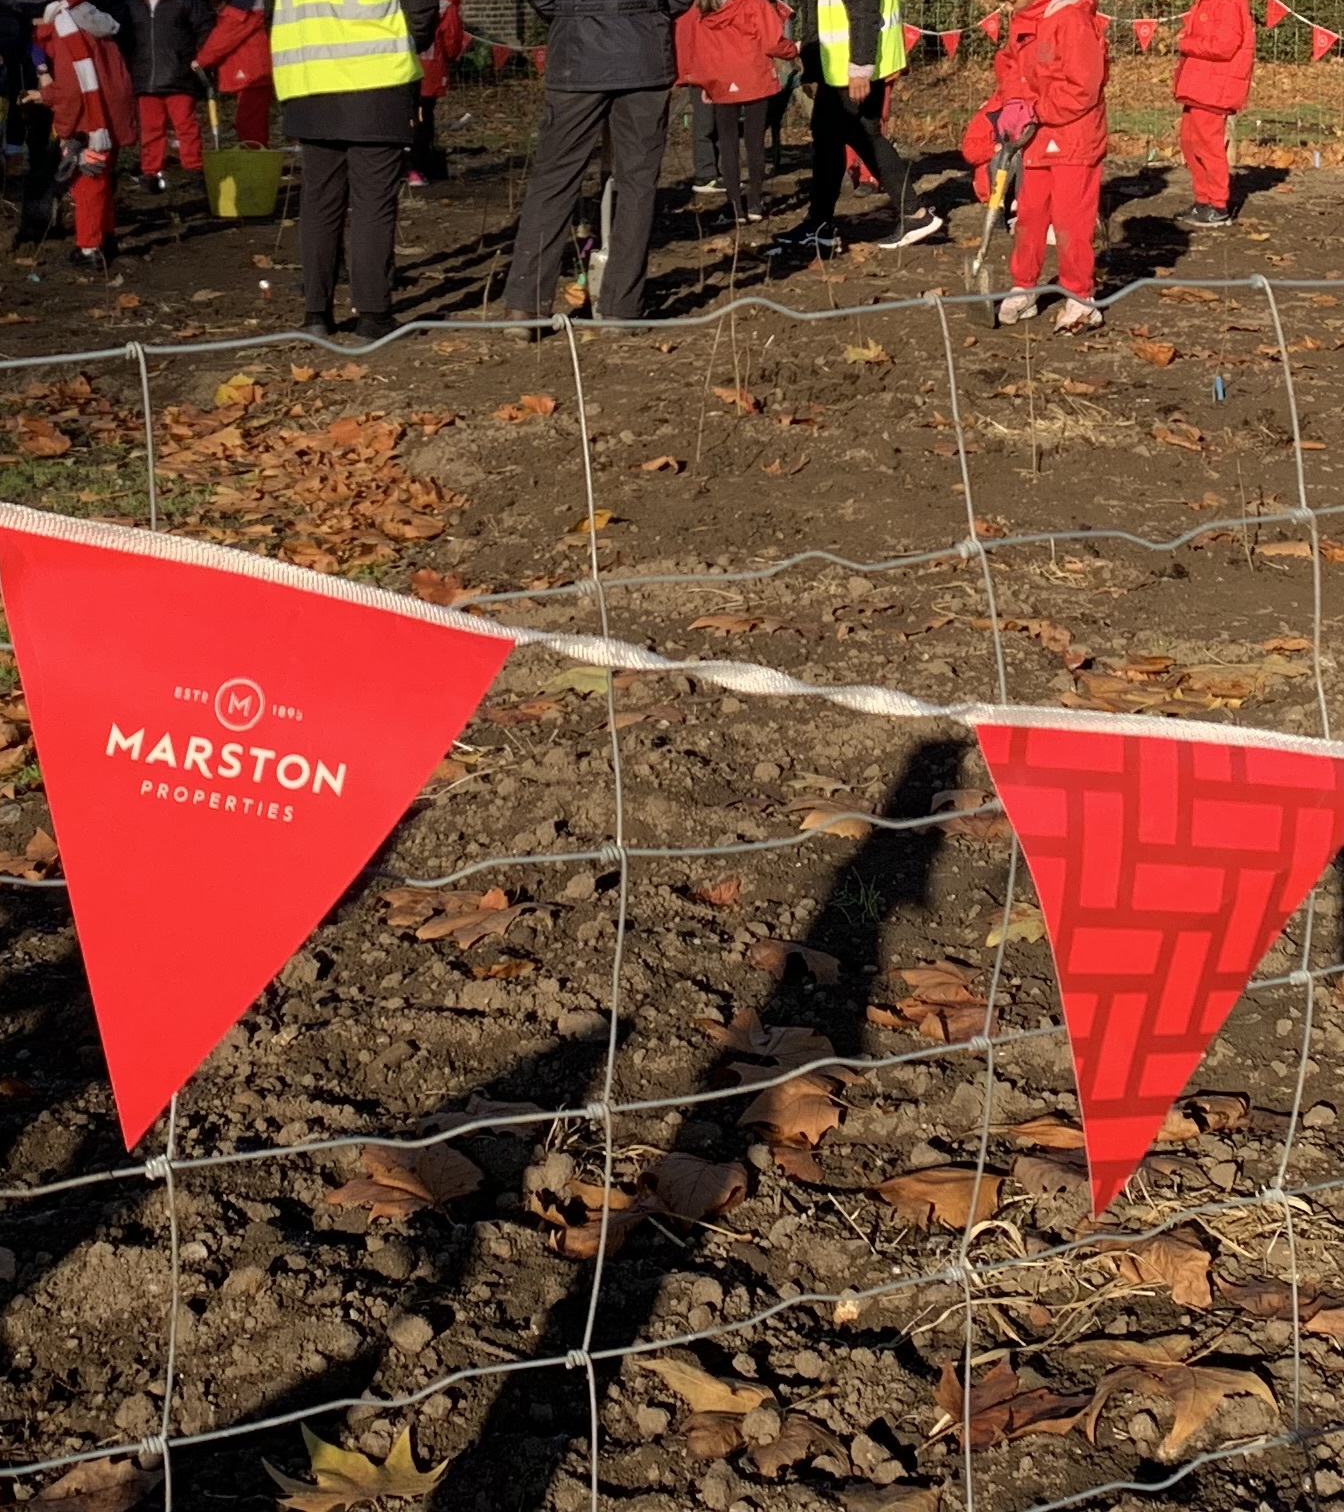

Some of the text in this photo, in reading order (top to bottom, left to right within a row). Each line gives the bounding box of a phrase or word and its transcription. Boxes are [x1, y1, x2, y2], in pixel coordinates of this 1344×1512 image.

[227, 691, 253, 718] M
[272, 704, 304, 722] 1895
[106, 721, 347, 798] MARSTON
[140, 779, 295, 823] PROPERTIES
